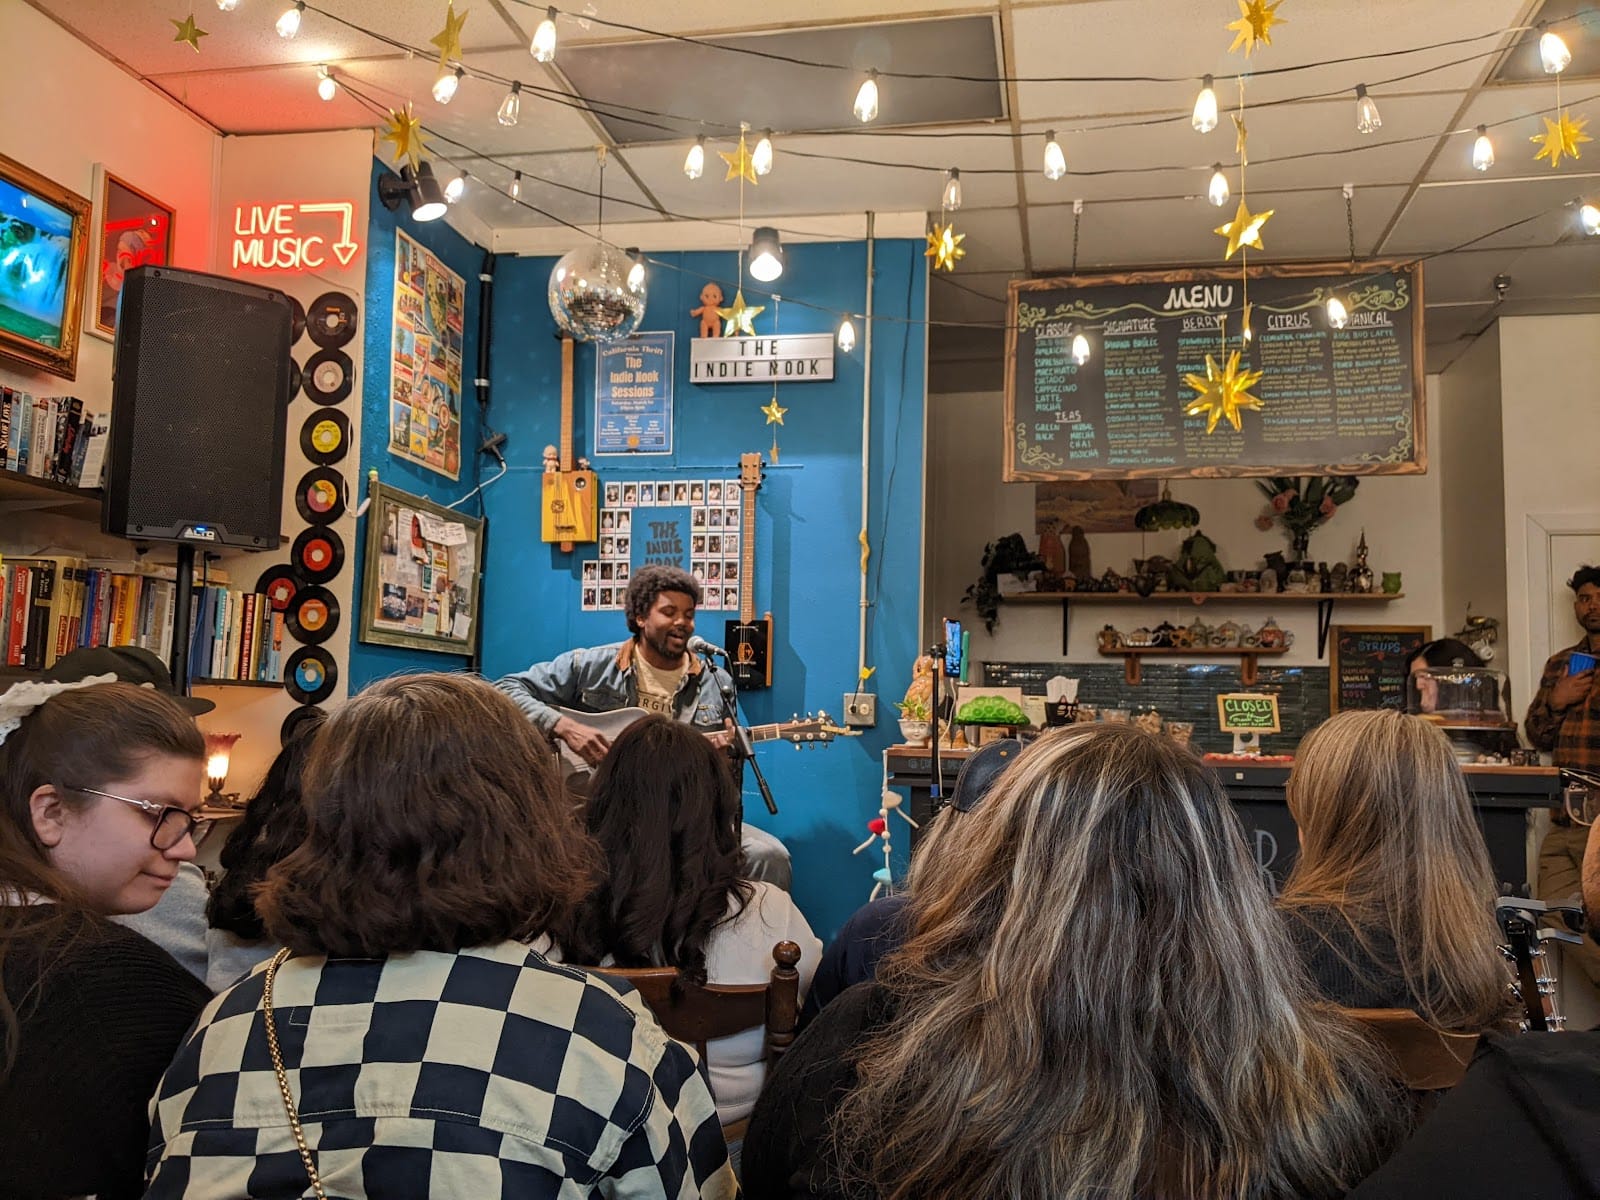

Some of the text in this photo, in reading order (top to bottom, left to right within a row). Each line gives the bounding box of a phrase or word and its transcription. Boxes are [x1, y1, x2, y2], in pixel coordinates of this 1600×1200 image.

[235, 204, 294, 235] LIVE
[232, 236, 324, 268] MUSIC
[1163, 284, 1233, 310] MENU
[1103, 318, 1157, 334] SIGNATURE
[1182, 316, 1222, 330] BERRY
[1267, 312, 1311, 329] CITRUS
[1347, 311, 1393, 327] TANICAL
[1035, 322, 1073, 338] CLASSIC
[603, 345, 664, 356] California Thrift
[740, 340, 778, 356] THE
[625, 356, 642, 369] The
[694, 359, 819, 378] INDIE NOOK
[610, 370, 659, 384] Indie Nook
[611, 385, 655, 398] Sessions
[1035, 394, 1062, 403] LATTE
[1055, 410, 1081, 421] TEAS
[1069, 440, 1091, 449] CHAI
[184, 527, 214, 538] ALTO
[648, 521, 679, 539] THE
[645, 539, 683, 555] INDIE
[245, 611, 253, 634] RULES
[1359, 641, 1401, 653] SYRUPS
[1225, 699, 1273, 712] CLOSED
